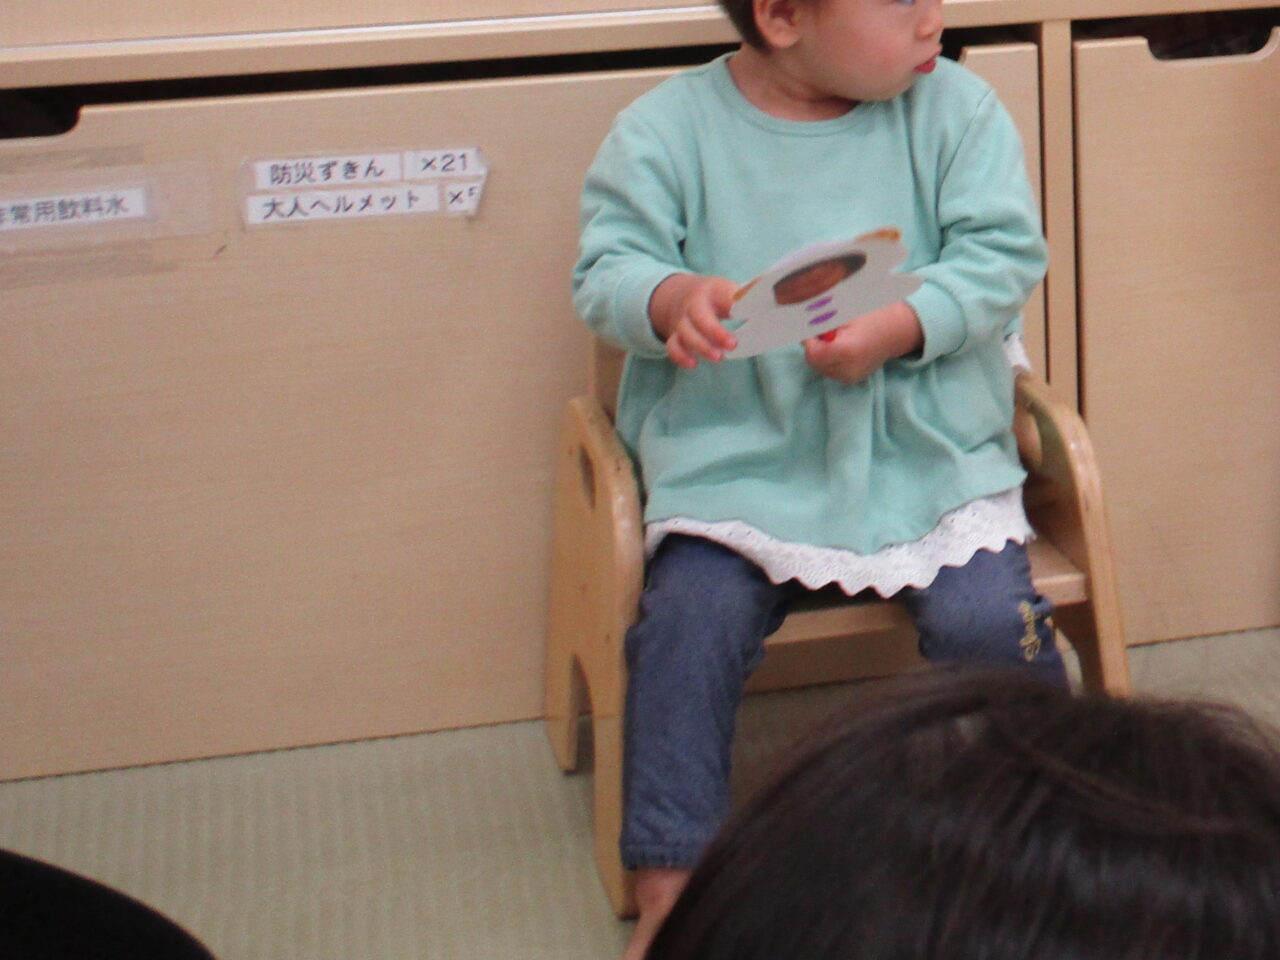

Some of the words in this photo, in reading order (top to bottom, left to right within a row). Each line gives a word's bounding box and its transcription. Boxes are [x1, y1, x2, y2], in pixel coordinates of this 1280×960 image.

[269, 159, 386, 185] 防災ずきん
[0, 193, 129, 226] 常用飲料水
[262, 188, 421, 220] 大人ヘルメット
